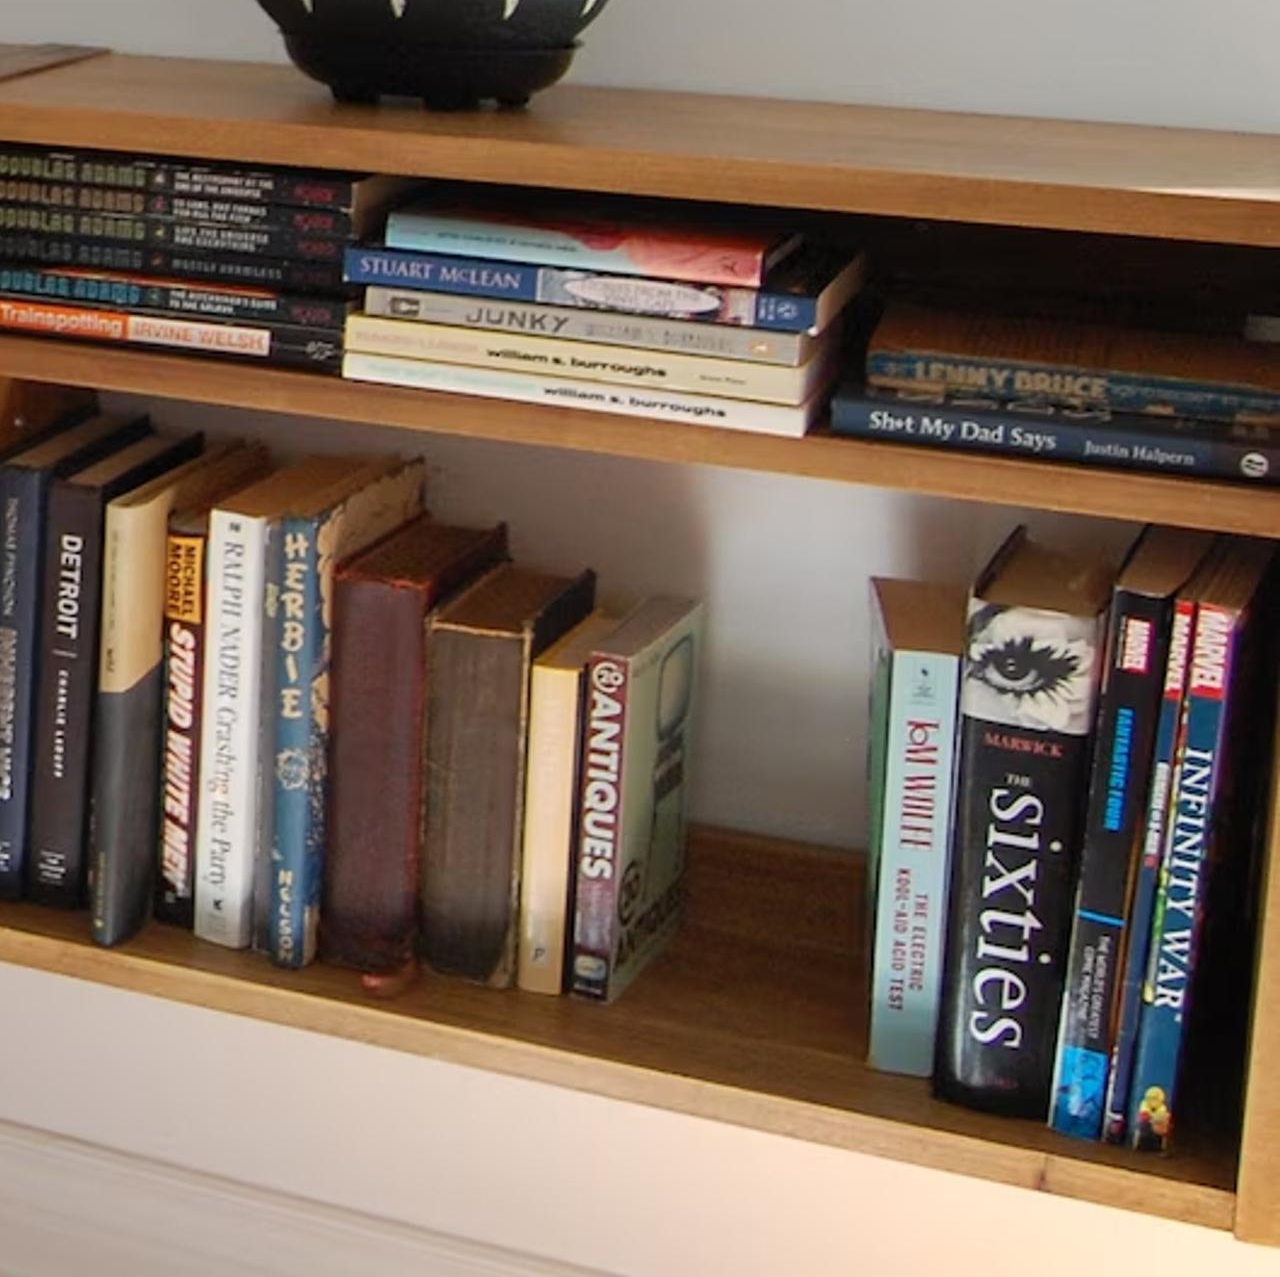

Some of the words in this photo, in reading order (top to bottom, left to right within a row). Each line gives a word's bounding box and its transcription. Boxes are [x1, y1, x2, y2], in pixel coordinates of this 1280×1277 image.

[80, 188, 144, 212] ADAMS
[81, 163, 146, 186] ADAMS
[80, 216, 144, 240] ADAMS
[79, 245, 141, 268] ADAMS
[360, 256, 434, 281] STUART
[74, 278, 140, 303] ADAMS
[0, 303, 123, 337] Trainspotting
[133, 320, 194, 343] IRVINE
[198, 329, 266, 351] WELSH
[466, 308, 569, 333] JUNKY
[487, 349, 548, 365] william
[570, 357, 667, 378] burroughs
[913, 360, 1010, 391] LENNY
[1013, 369, 1110, 399] BRUCE
[543, 386, 606, 402] william
[629, 397, 727, 417] burroughs
[920, 415, 955, 440] My
[961, 421, 1003, 445] Dad
[1010, 427, 1057, 452] Says
[1083, 440, 1128, 458] Justin
[1132, 446, 1195, 466] Halpern
[5, 497, 20, 551] THOMAS
[55, 532, 83, 640] DETROIT
[167, 546, 182, 615] MOORE
[181, 544, 197, 617] MICHAEL
[221, 540, 245, 618] RALPH
[280, 532, 309, 719] HERBIE
[1165, 612, 1192, 692] MARVEL
[1190, 608, 1232, 689] MARVEL
[166, 624, 197, 727] STUPID
[218, 625, 241, 698] NADER
[55, 669, 70, 725] CHARLIE
[209, 705, 238, 795] Crashing
[905, 719, 940, 766] TOM
[981, 731, 1064, 759] MARWICK
[1108, 707, 1135, 788] FANTASTIC
[162, 728, 196, 823] WHITE
[580, 689, 625, 881] ANTIQUES
[1004, 772, 1032, 787] THE
[212, 800, 232, 835] the
[899, 774, 937, 853] WOLFE
[1103, 789, 1129, 832] FOUR
[1162, 746, 1214, 918] INFINITY
[160, 824, 191, 885] MEN
[203, 835, 232, 891] Party
[891, 867, 912, 936] KOOL-AID
[912, 892, 930, 922] THE
[969, 787, 1063, 1051] sixties
[890, 939, 909, 973] ACID
[908, 925, 929, 994] ELECTRIC
[1152, 923, 1195, 1010] WAR
[887, 977, 907, 1012] TEST
